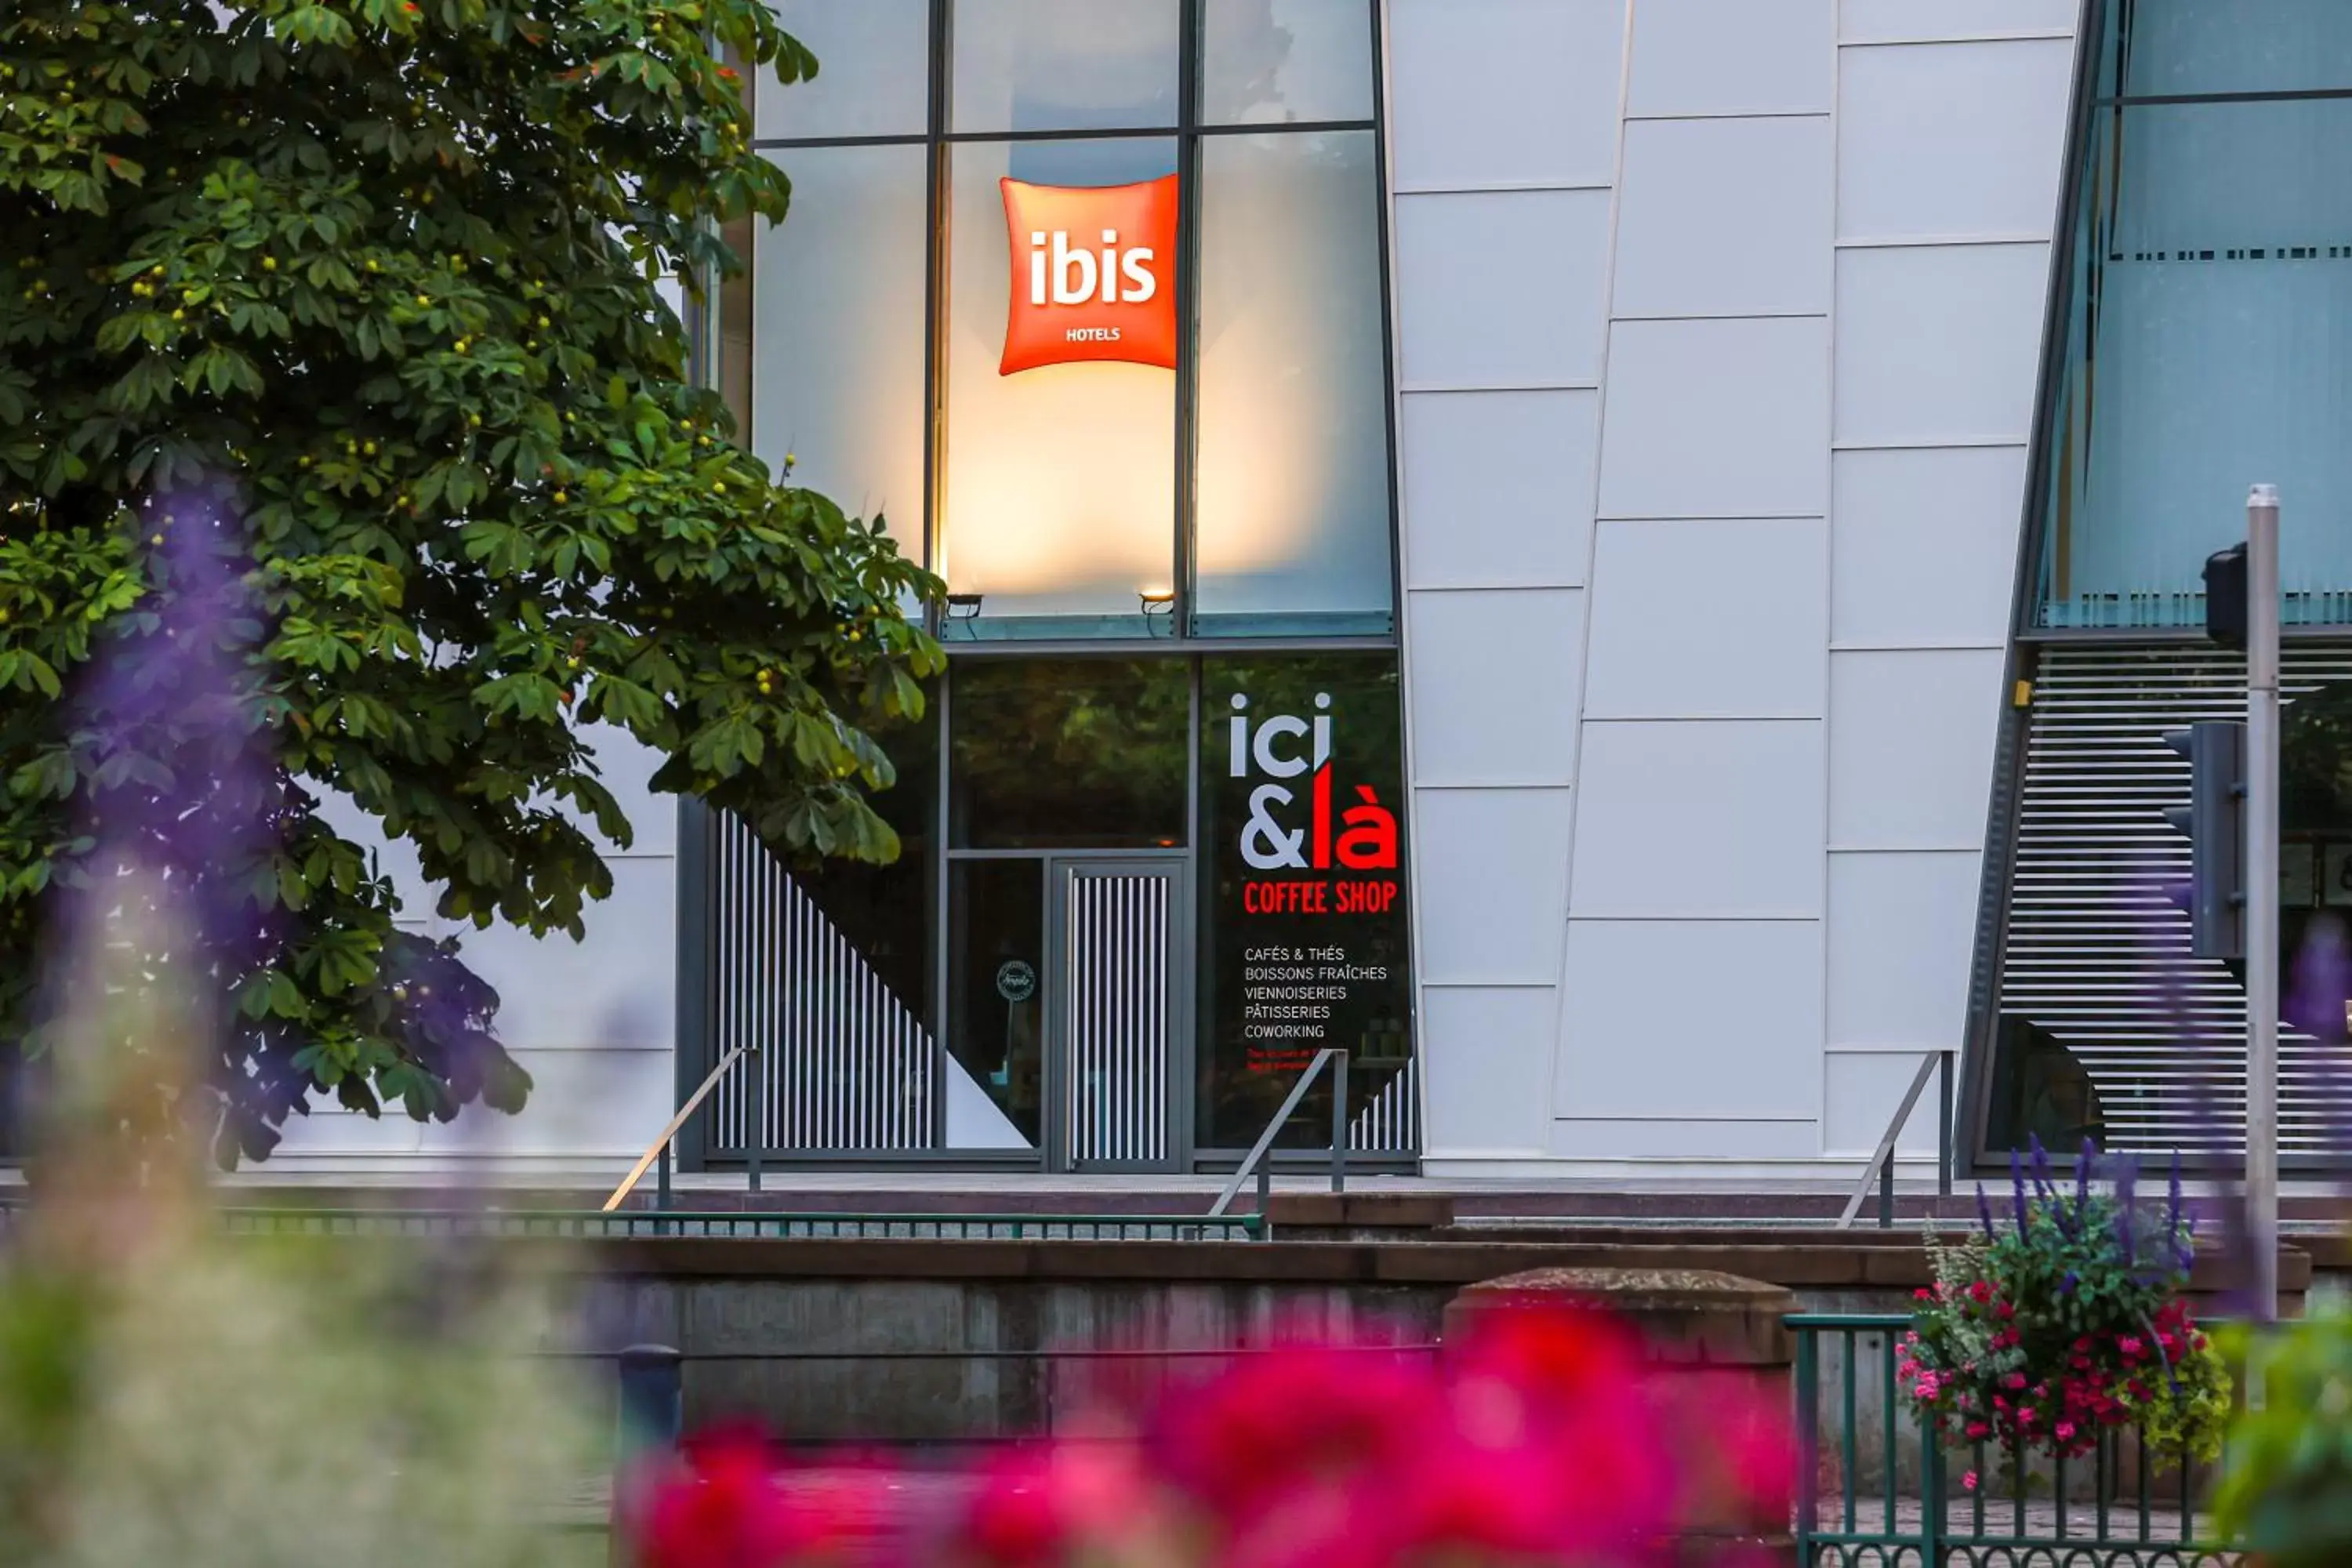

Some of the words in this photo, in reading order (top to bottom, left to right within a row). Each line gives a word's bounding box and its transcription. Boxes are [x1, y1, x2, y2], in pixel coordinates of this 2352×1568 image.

[1031, 229, 1156, 304] ibis
[1066, 327, 1120, 341] HOTELS
[1230, 692, 1330, 778] ici
[1240, 784, 1308, 869] &
[1313, 761, 1396, 869] là
[1244, 881, 1327, 913] COFFEE
[1335, 881, 1398, 913] SHOP
[1245, 946, 1289, 960] CAFÉS
[1294, 948, 1303, 960] &
[1308, 946, 1345, 960] THÉS
[1245, 967, 1314, 980] BOISSONS
[1319, 964, 1387, 979] FRAÎCHES
[1245, 987, 1347, 1000] VIENNOISERIES
[1245, 1004, 1330, 1018] PÂTISSERIES
[1245, 1025, 1324, 1038] COWORKING
